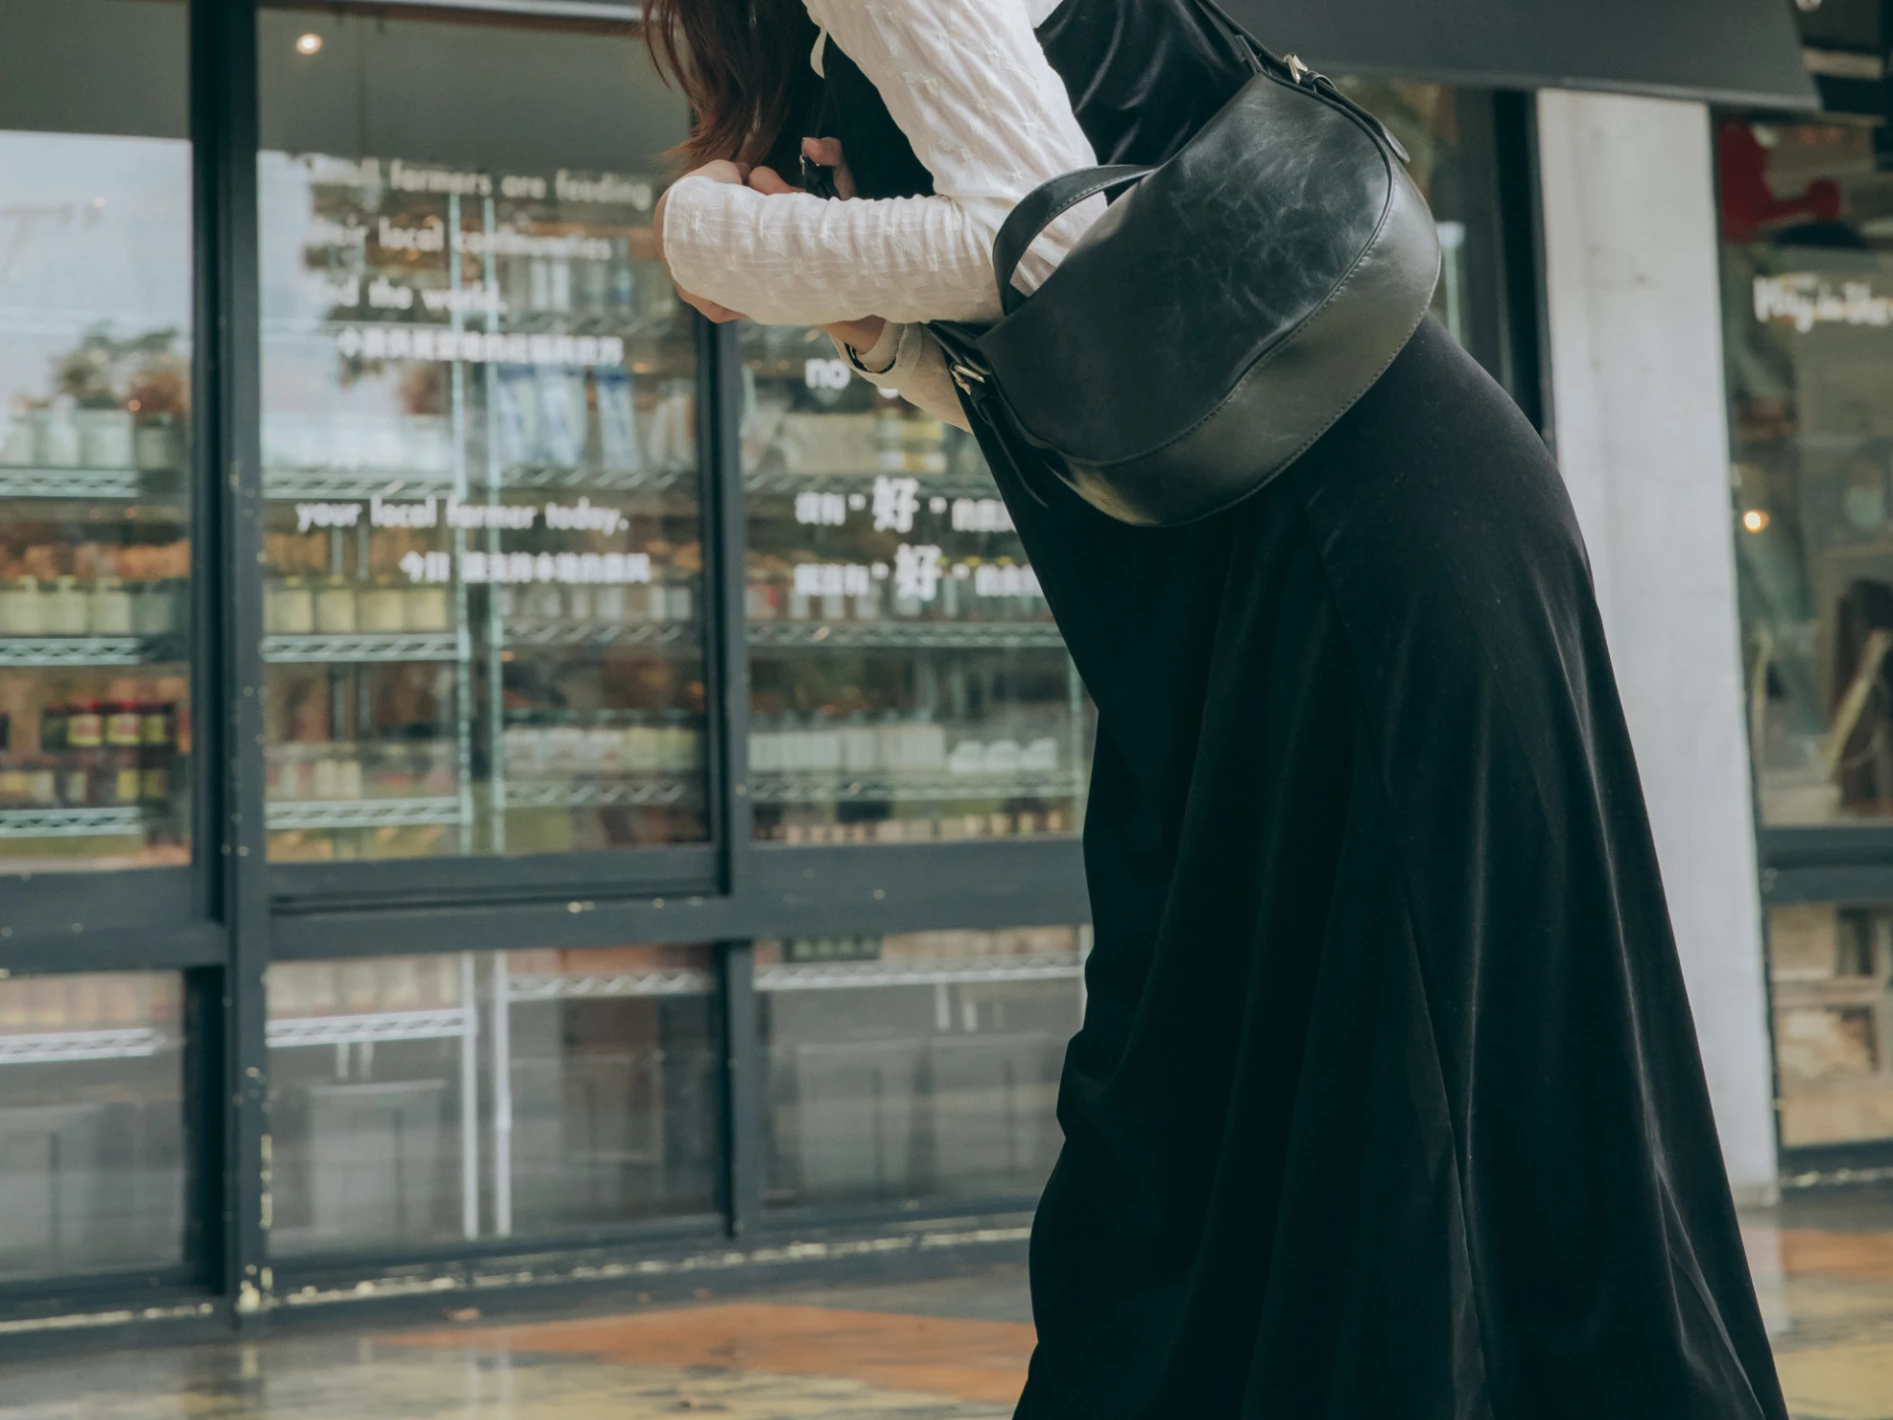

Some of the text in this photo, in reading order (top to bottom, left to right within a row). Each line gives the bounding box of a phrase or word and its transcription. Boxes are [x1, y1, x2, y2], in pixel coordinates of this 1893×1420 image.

[390, 157, 493, 197] farmers
[501, 174, 547, 200] are
[555, 168, 653, 212] feeding
[378, 216, 445, 252] local
[368, 276, 414, 311] the
[294, 493, 630, 537] your local farmer today.
